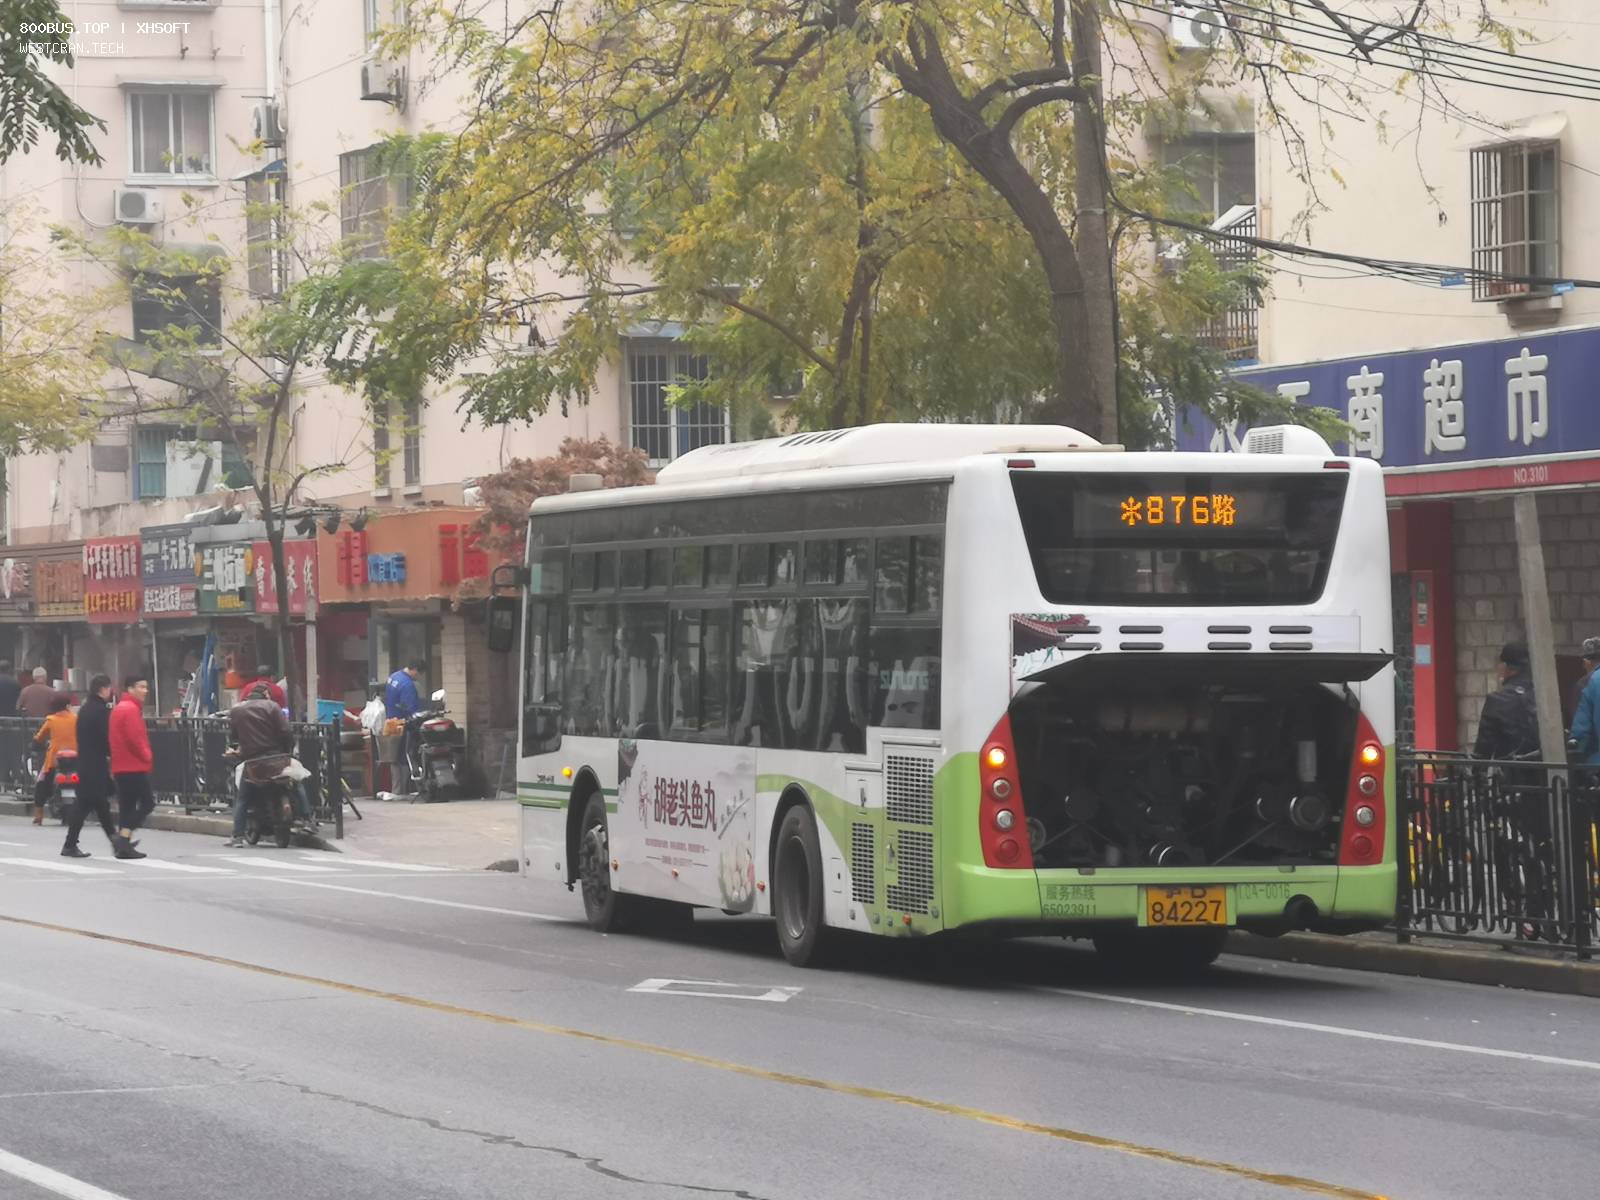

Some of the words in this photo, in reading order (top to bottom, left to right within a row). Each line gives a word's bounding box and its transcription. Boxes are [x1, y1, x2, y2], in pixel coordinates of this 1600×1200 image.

[1513, 464, 1549, 484] NO.3101
[653, 776, 717, 832] 胡老头鱼丸
[1151, 900, 1222, 923] 84227
